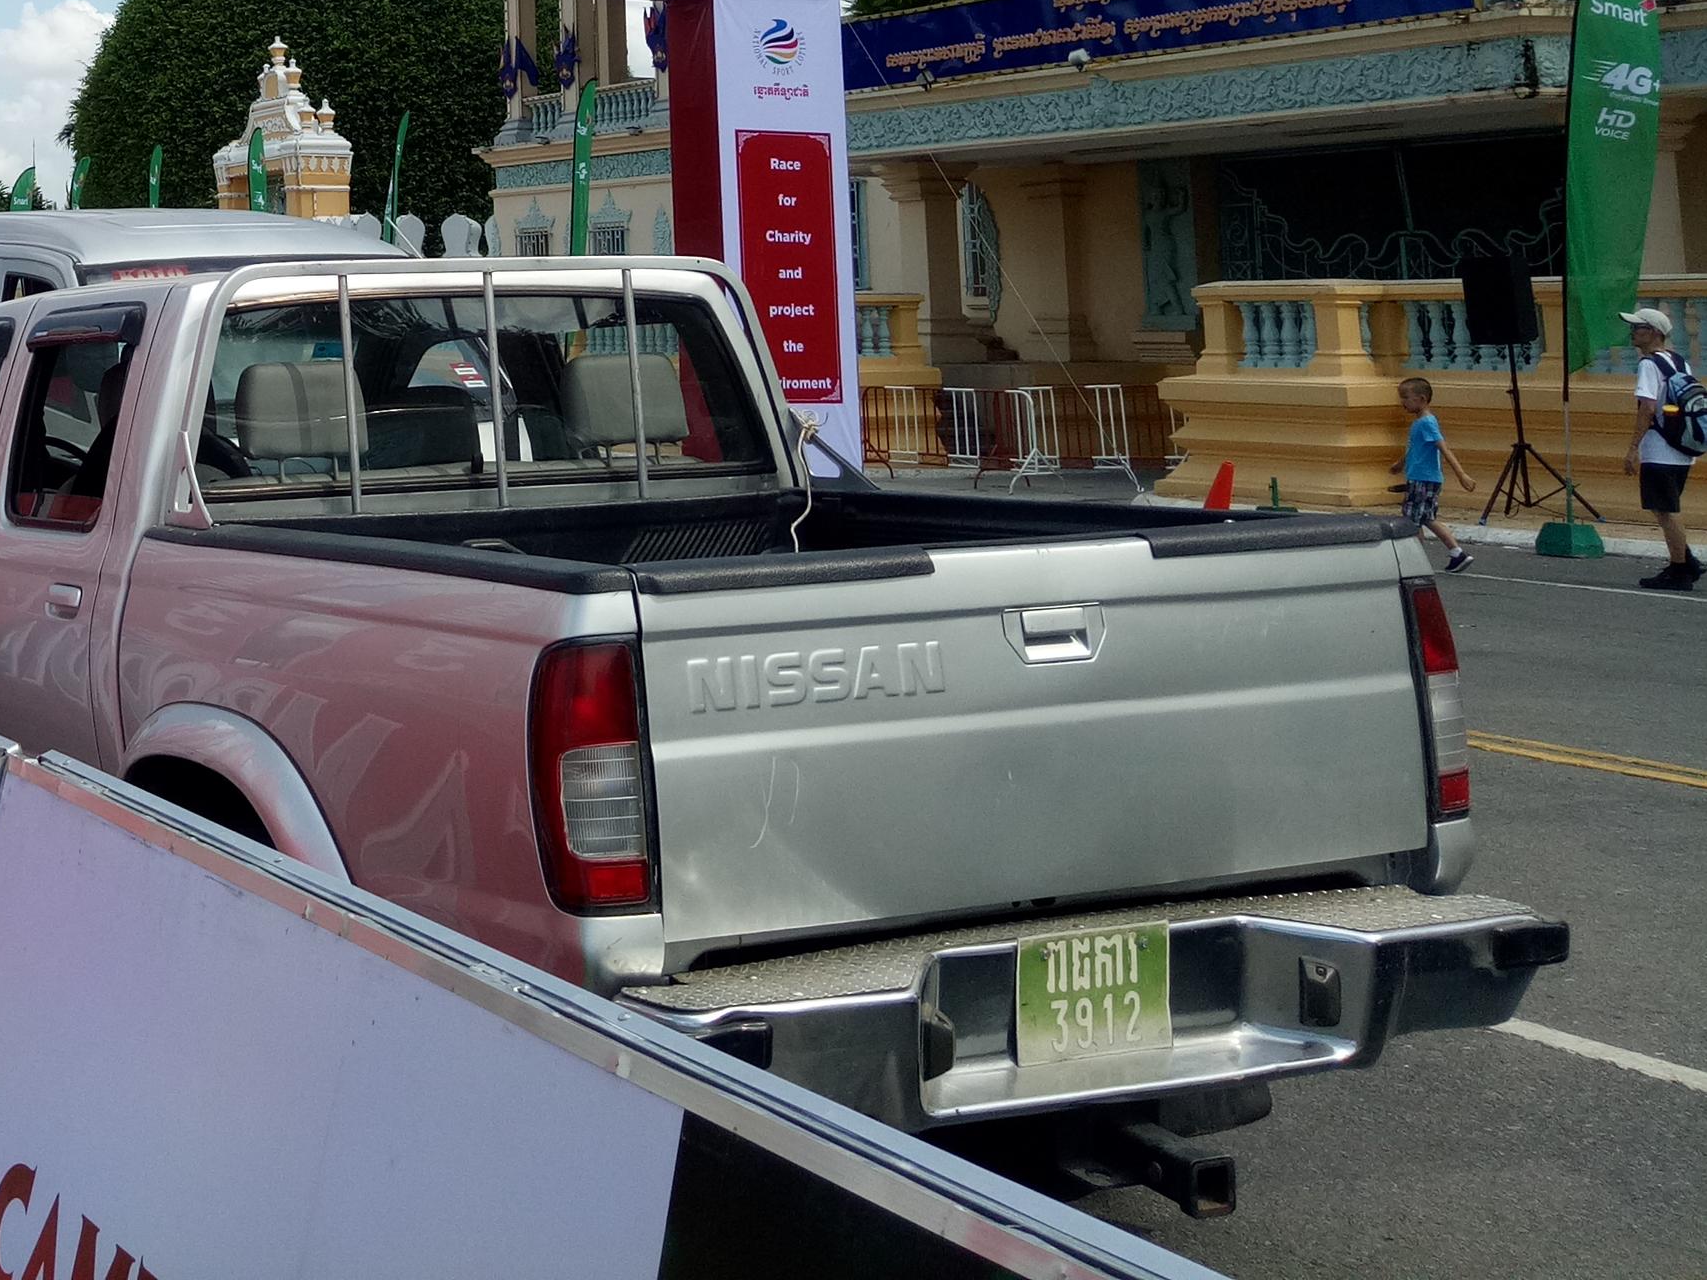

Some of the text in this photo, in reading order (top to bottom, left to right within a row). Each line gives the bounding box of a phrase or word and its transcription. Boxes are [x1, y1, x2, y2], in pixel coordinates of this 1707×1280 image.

[1597, 107, 1636, 128] HD
[1595, 126, 1631, 140] VOICE
[770, 157, 802, 171] Race
[778, 193, 797, 206] for
[765, 230, 812, 245] Charity
[778, 267, 803, 280] and
[769, 303, 815, 319] project
[782, 339, 804, 353] the
[686, 640, 946, 714] NISSAN
[1050, 990, 1143, 1053] 3912
